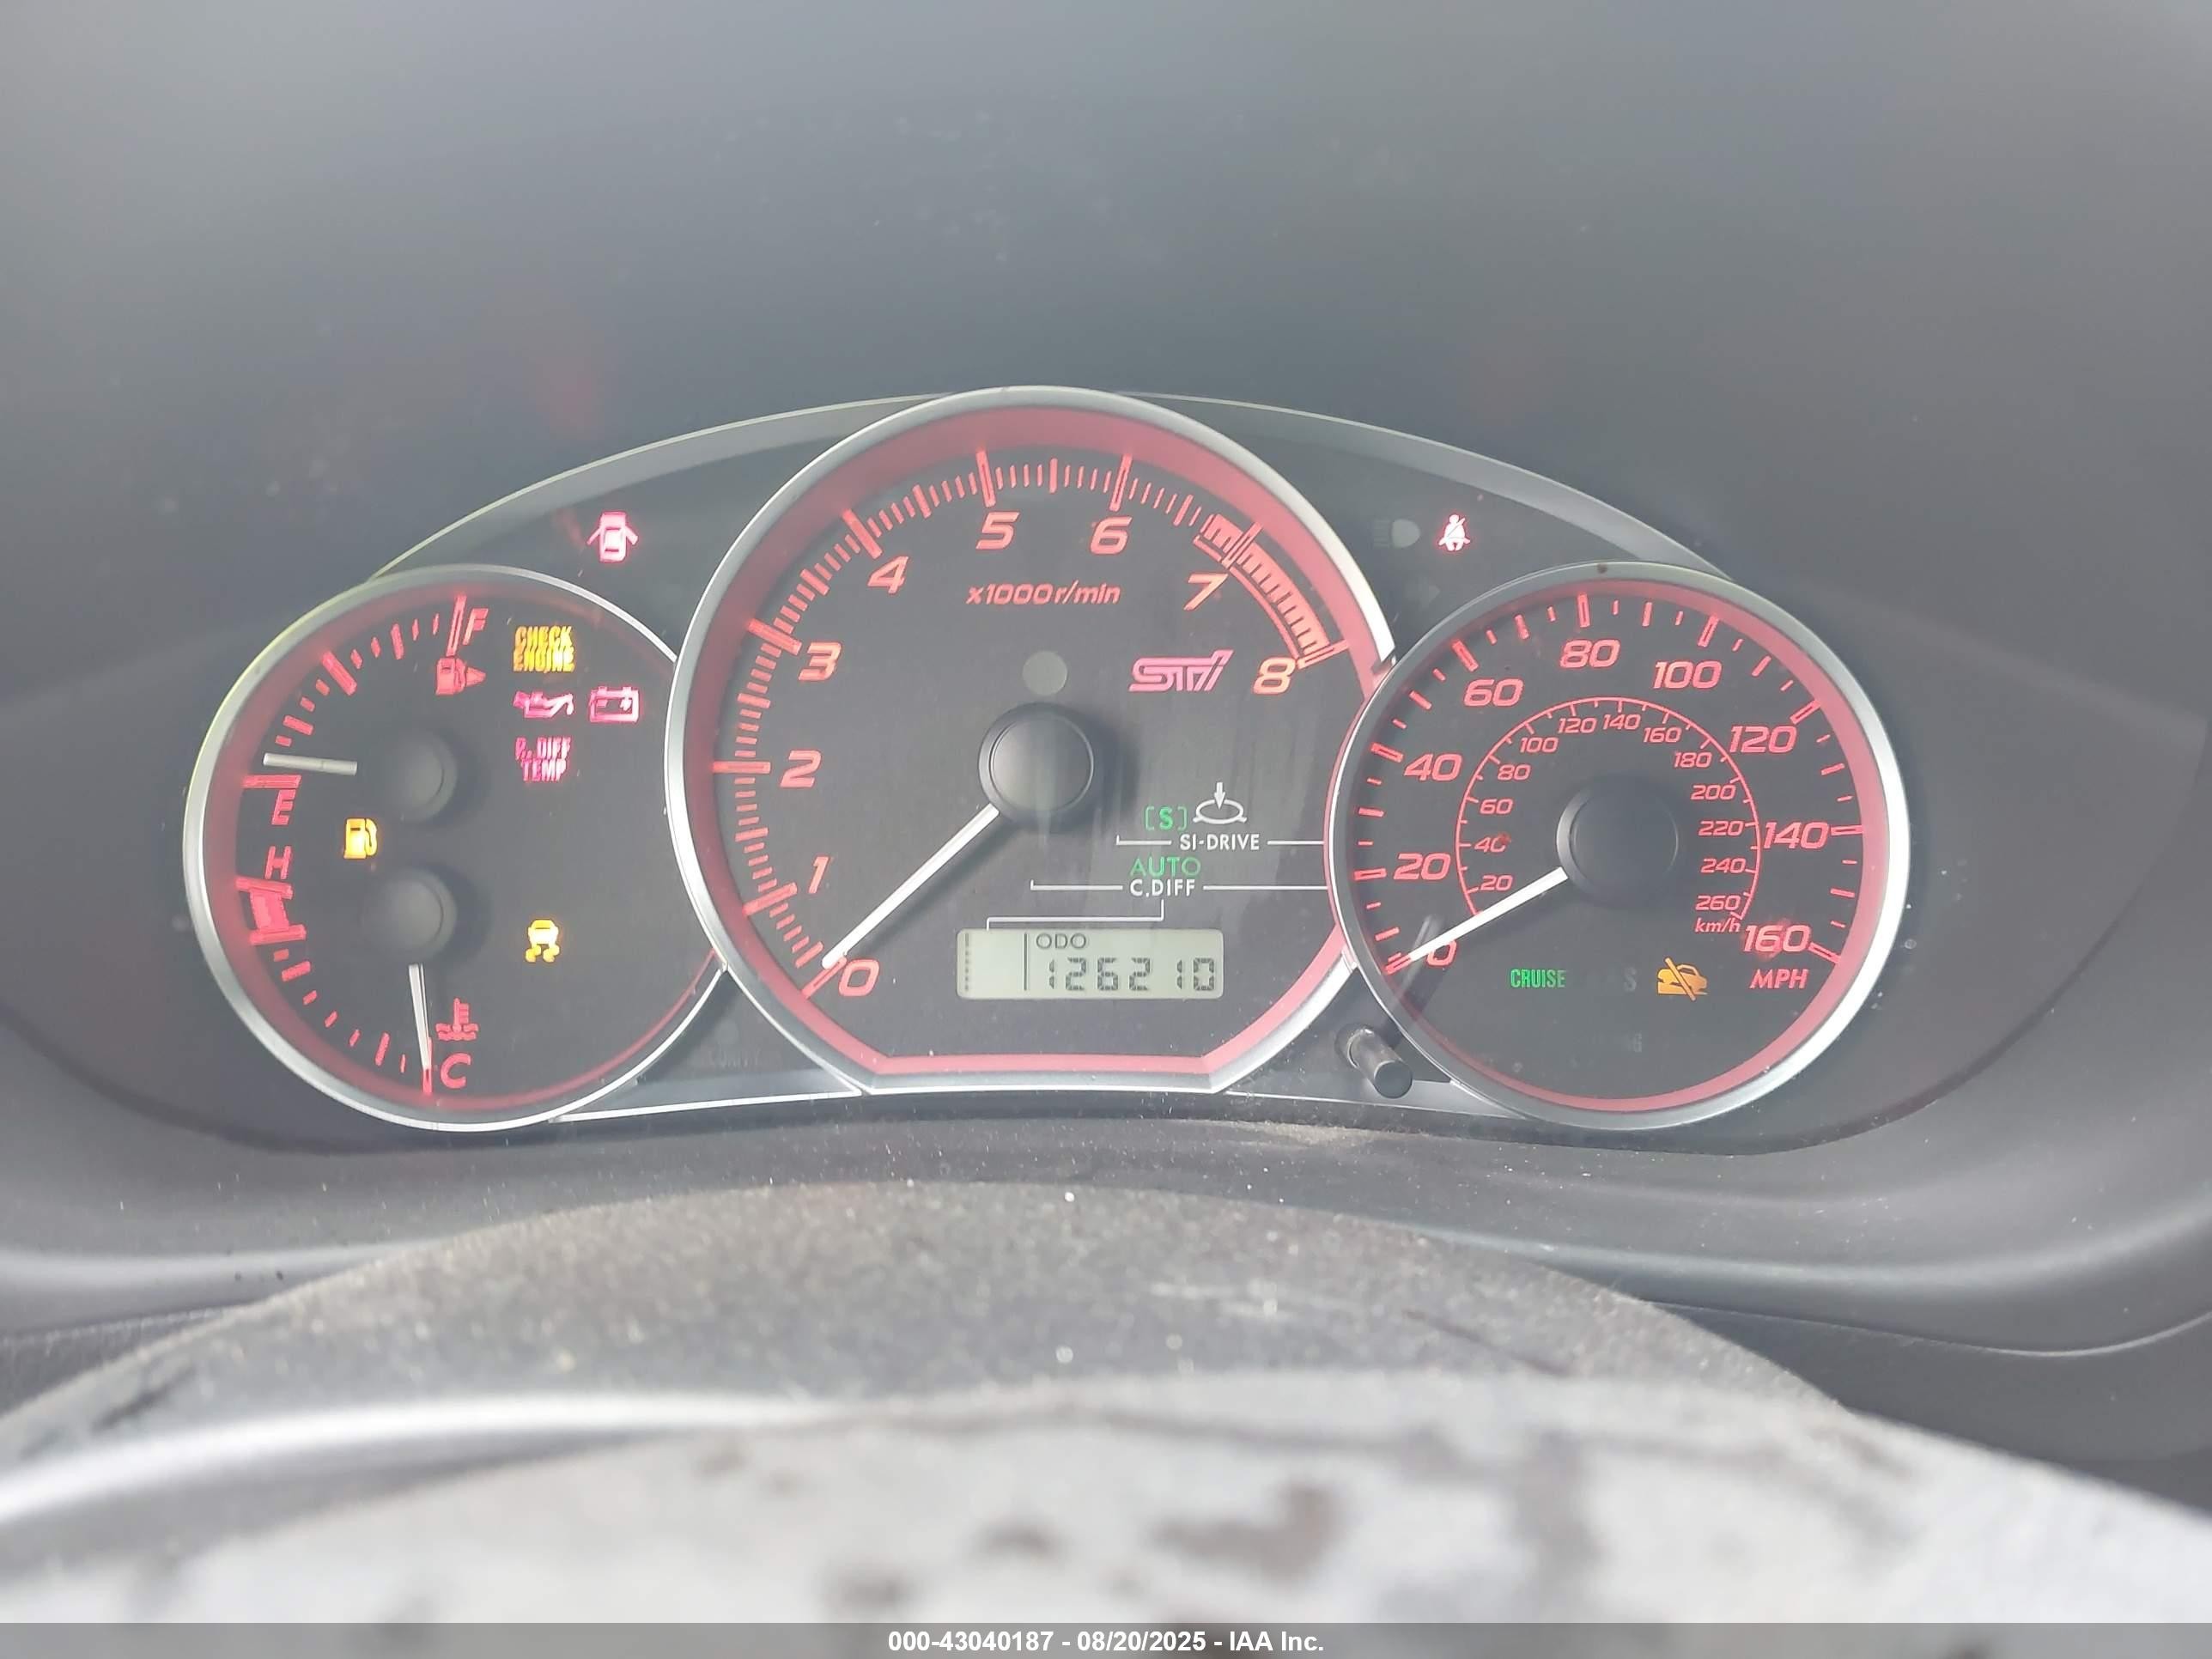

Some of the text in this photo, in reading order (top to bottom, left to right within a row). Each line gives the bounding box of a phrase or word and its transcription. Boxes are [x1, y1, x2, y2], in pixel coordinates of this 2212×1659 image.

[976, 512, 1019, 550] 5
[1090, 517, 1132, 555] 6
[867, 556, 909, 594] 4
[1184, 573, 1228, 611] 7
[463, 608, 489, 645] F
[515, 626, 573, 649] CHECK
[799, 641, 842, 681] 3
[1559, 639, 1621, 668] 80
[1253, 658, 1297, 694] 8
[1653, 661, 1722, 690] 100
[1463, 678, 1523, 707] 60
[1558, 718, 1597, 733] 120
[1602, 714, 1641, 730] 140
[1643, 728, 1682, 743] 160
[537, 737, 572, 759] DIFF
[1520, 737, 1559, 753] 100
[1729, 726, 1797, 754] 120
[522, 758, 567, 782] TEMP
[780, 750, 822, 787] 2
[1404, 753, 1462, 781] 40
[1497, 764, 1531, 781] 80
[1674, 751, 1712, 768] 180
[1690, 785, 1736, 800] 200
[271, 789, 296, 825] E
[1480, 799, 1514, 815] 60
[1179, 833, 1261, 851] SI-DRIVE
[1698, 821, 1744, 836] 220
[1764, 822, 1827, 849] 140
[264, 845, 292, 880] H
[809, 855, 831, 895] 1
[1130, 856, 1202, 877] AUTO
[1394, 853, 1452, 880] 20
[1700, 859, 1746, 873] 240
[1129, 878, 1196, 897] C.DIFF
[1480, 875, 1513, 891] 20
[1694, 895, 1741, 911] 260
[1694, 918, 1741, 933] km/h
[1744, 924, 1812, 953] 160
[1036, 933, 1087, 951] ODO
[1426, 937, 1458, 967] 0
[839, 959, 880, 997] 0
[1048, 957, 1215, 992] 126210
[1510, 969, 1566, 988] CRUISE
[1749, 969, 1809, 990] MPH
[440, 1053, 471, 1090] C
